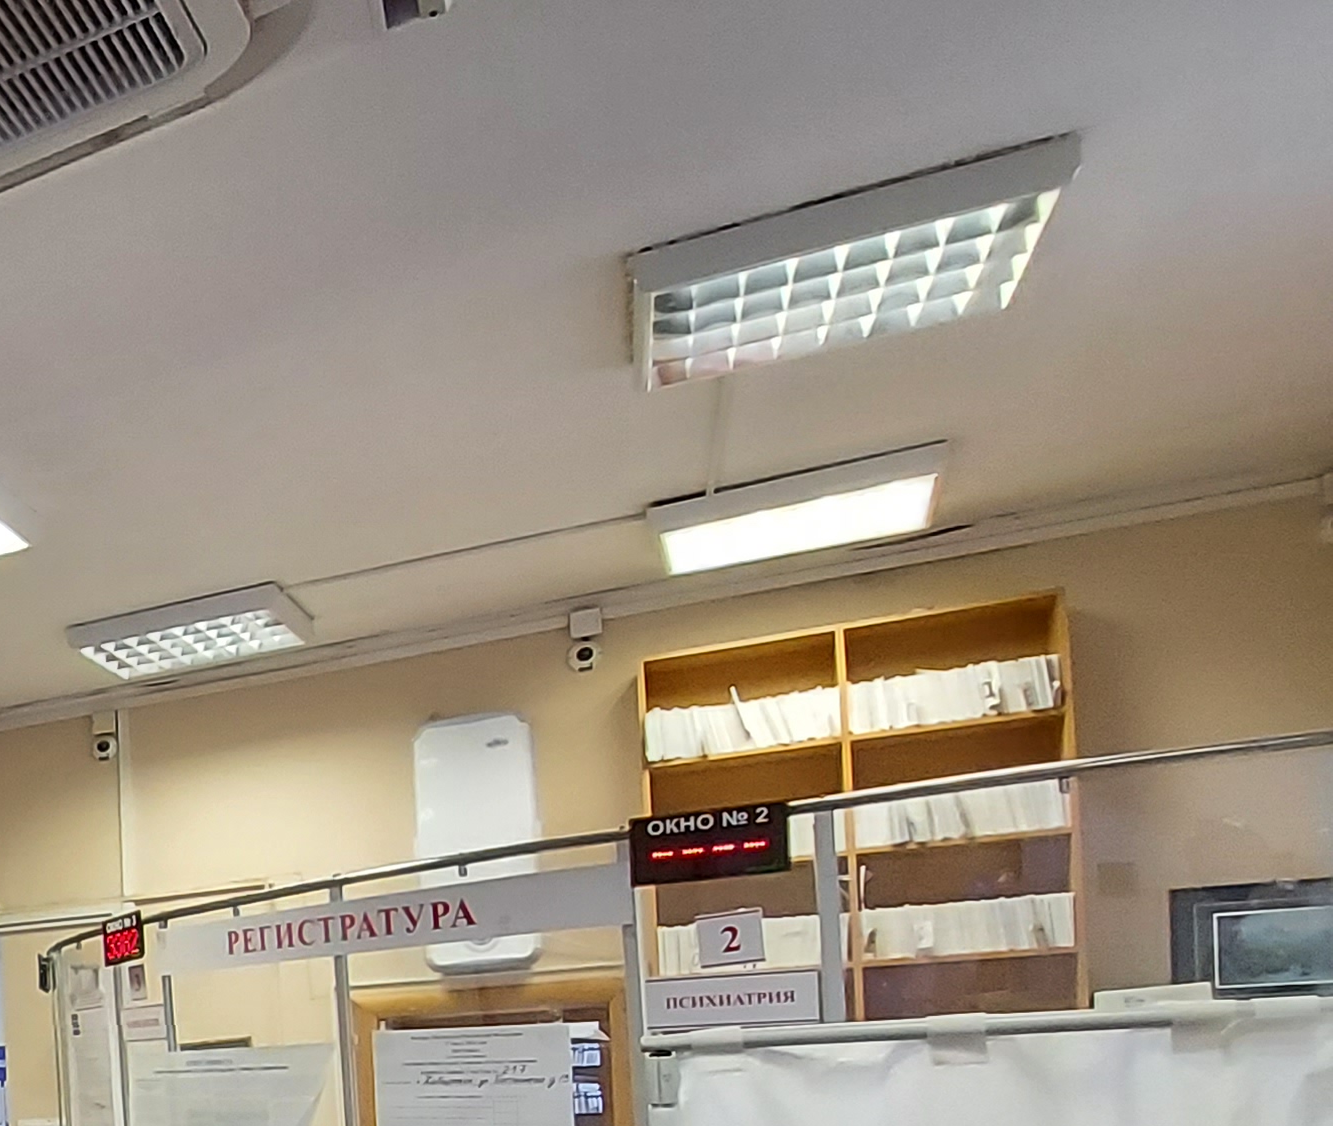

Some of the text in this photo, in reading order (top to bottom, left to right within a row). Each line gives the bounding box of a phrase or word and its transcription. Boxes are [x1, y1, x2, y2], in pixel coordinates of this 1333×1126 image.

[646, 806, 770, 837] ОКНО № 2
[227, 898, 478, 956] РЕГИСТРАТУРА
[720, 926, 742, 953] 2
[665, 990, 796, 1010] ПСИХИАТРИЯ
